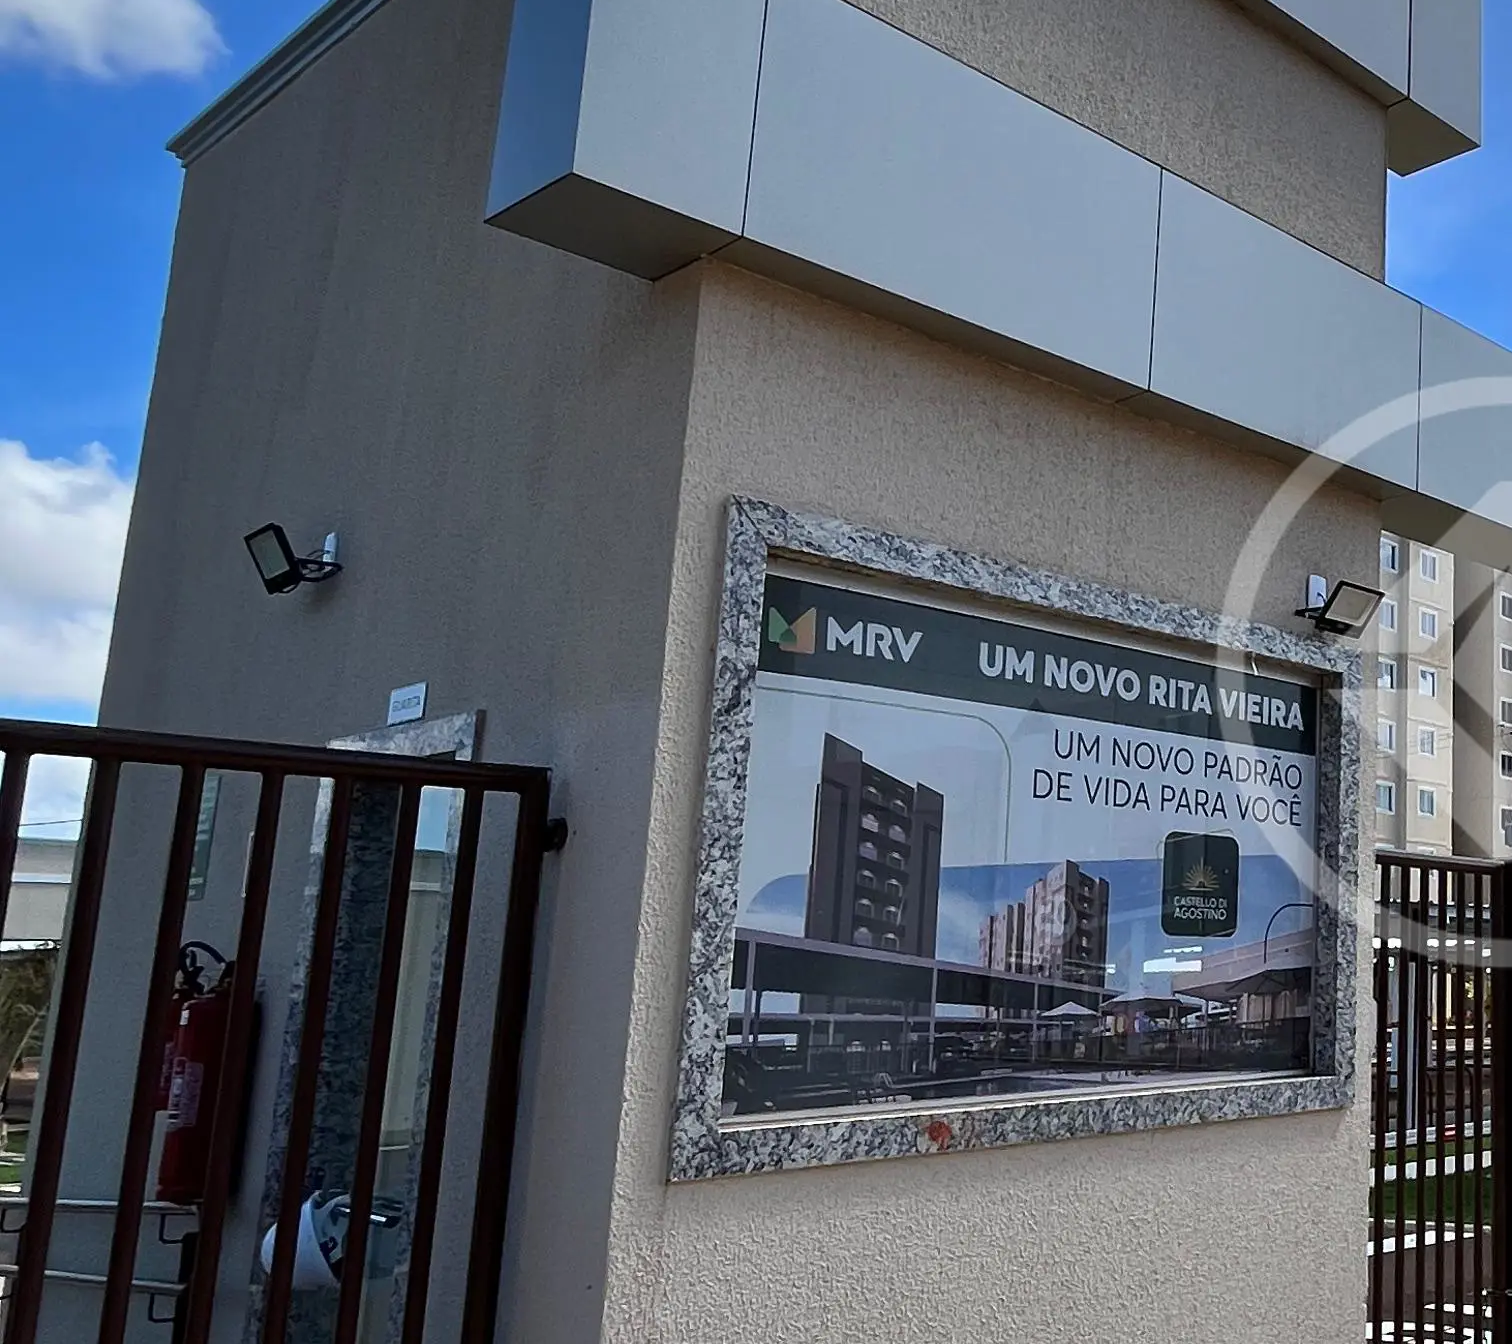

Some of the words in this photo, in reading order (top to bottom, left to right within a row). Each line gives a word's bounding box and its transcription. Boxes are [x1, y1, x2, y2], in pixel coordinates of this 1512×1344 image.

[826, 615, 924, 664] MRV
[978, 641, 1035, 684] UM
[1043, 653, 1142, 702] NOVO
[1149, 674, 1213, 716] RITA
[1218, 687, 1305, 732] VIEIRA
[1054, 728, 1101, 765] UM
[1111, 736, 1195, 776] NOVO
[1203, 750, 1303, 791] PADRÃO
[1032, 768, 1073, 803] DE
[1083, 774, 1151, 812] VIDA
[1159, 784, 1228, 820] PARA
[1235, 792, 1302, 827] VOCÊ
[1173, 895, 1217, 909] CASTELLO
[1219, 898, 1228, 909] DI
[1173, 907, 1228, 921] AGOSTINO
